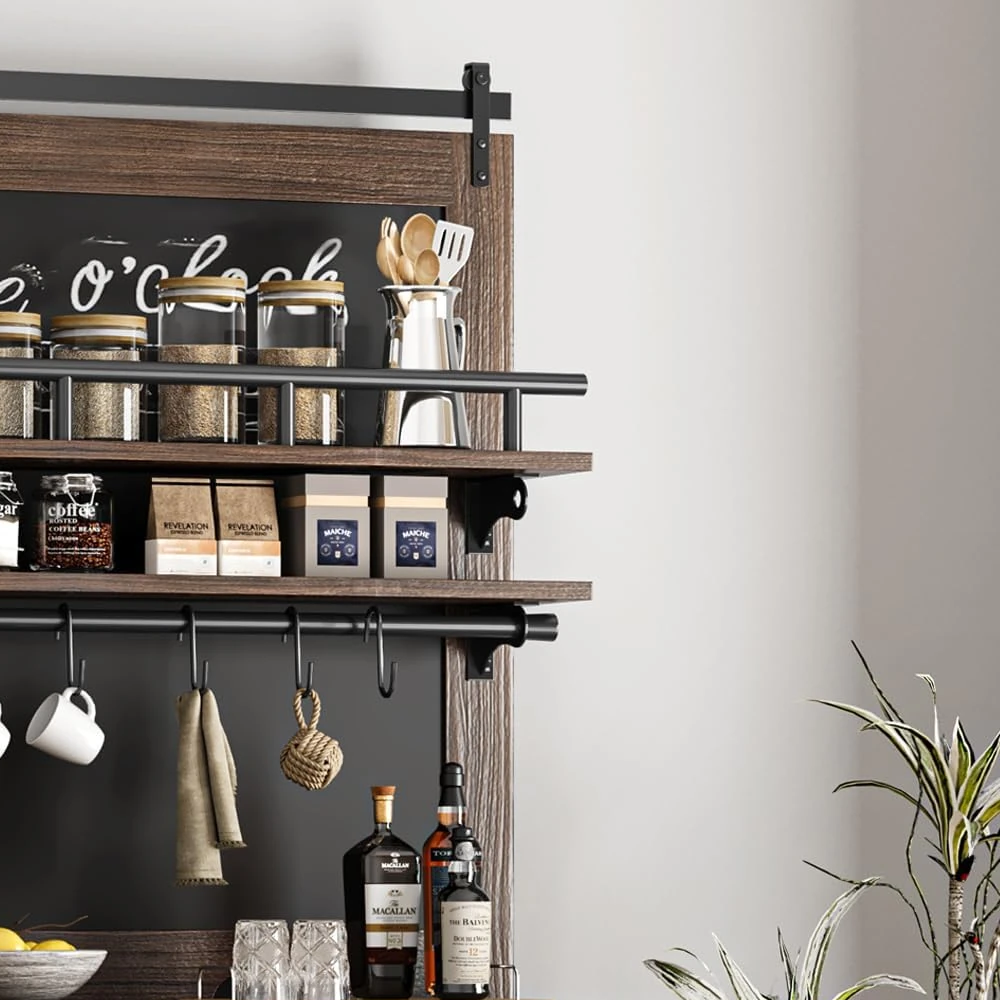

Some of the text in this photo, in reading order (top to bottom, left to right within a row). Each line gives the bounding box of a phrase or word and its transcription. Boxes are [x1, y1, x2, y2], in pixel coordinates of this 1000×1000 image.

[48, 502, 97, 518] coffee
[163, 521, 209, 531] REVELATION
[227, 523, 273, 533] REVELATION
[372, 907, 418, 916] MACALLAN
